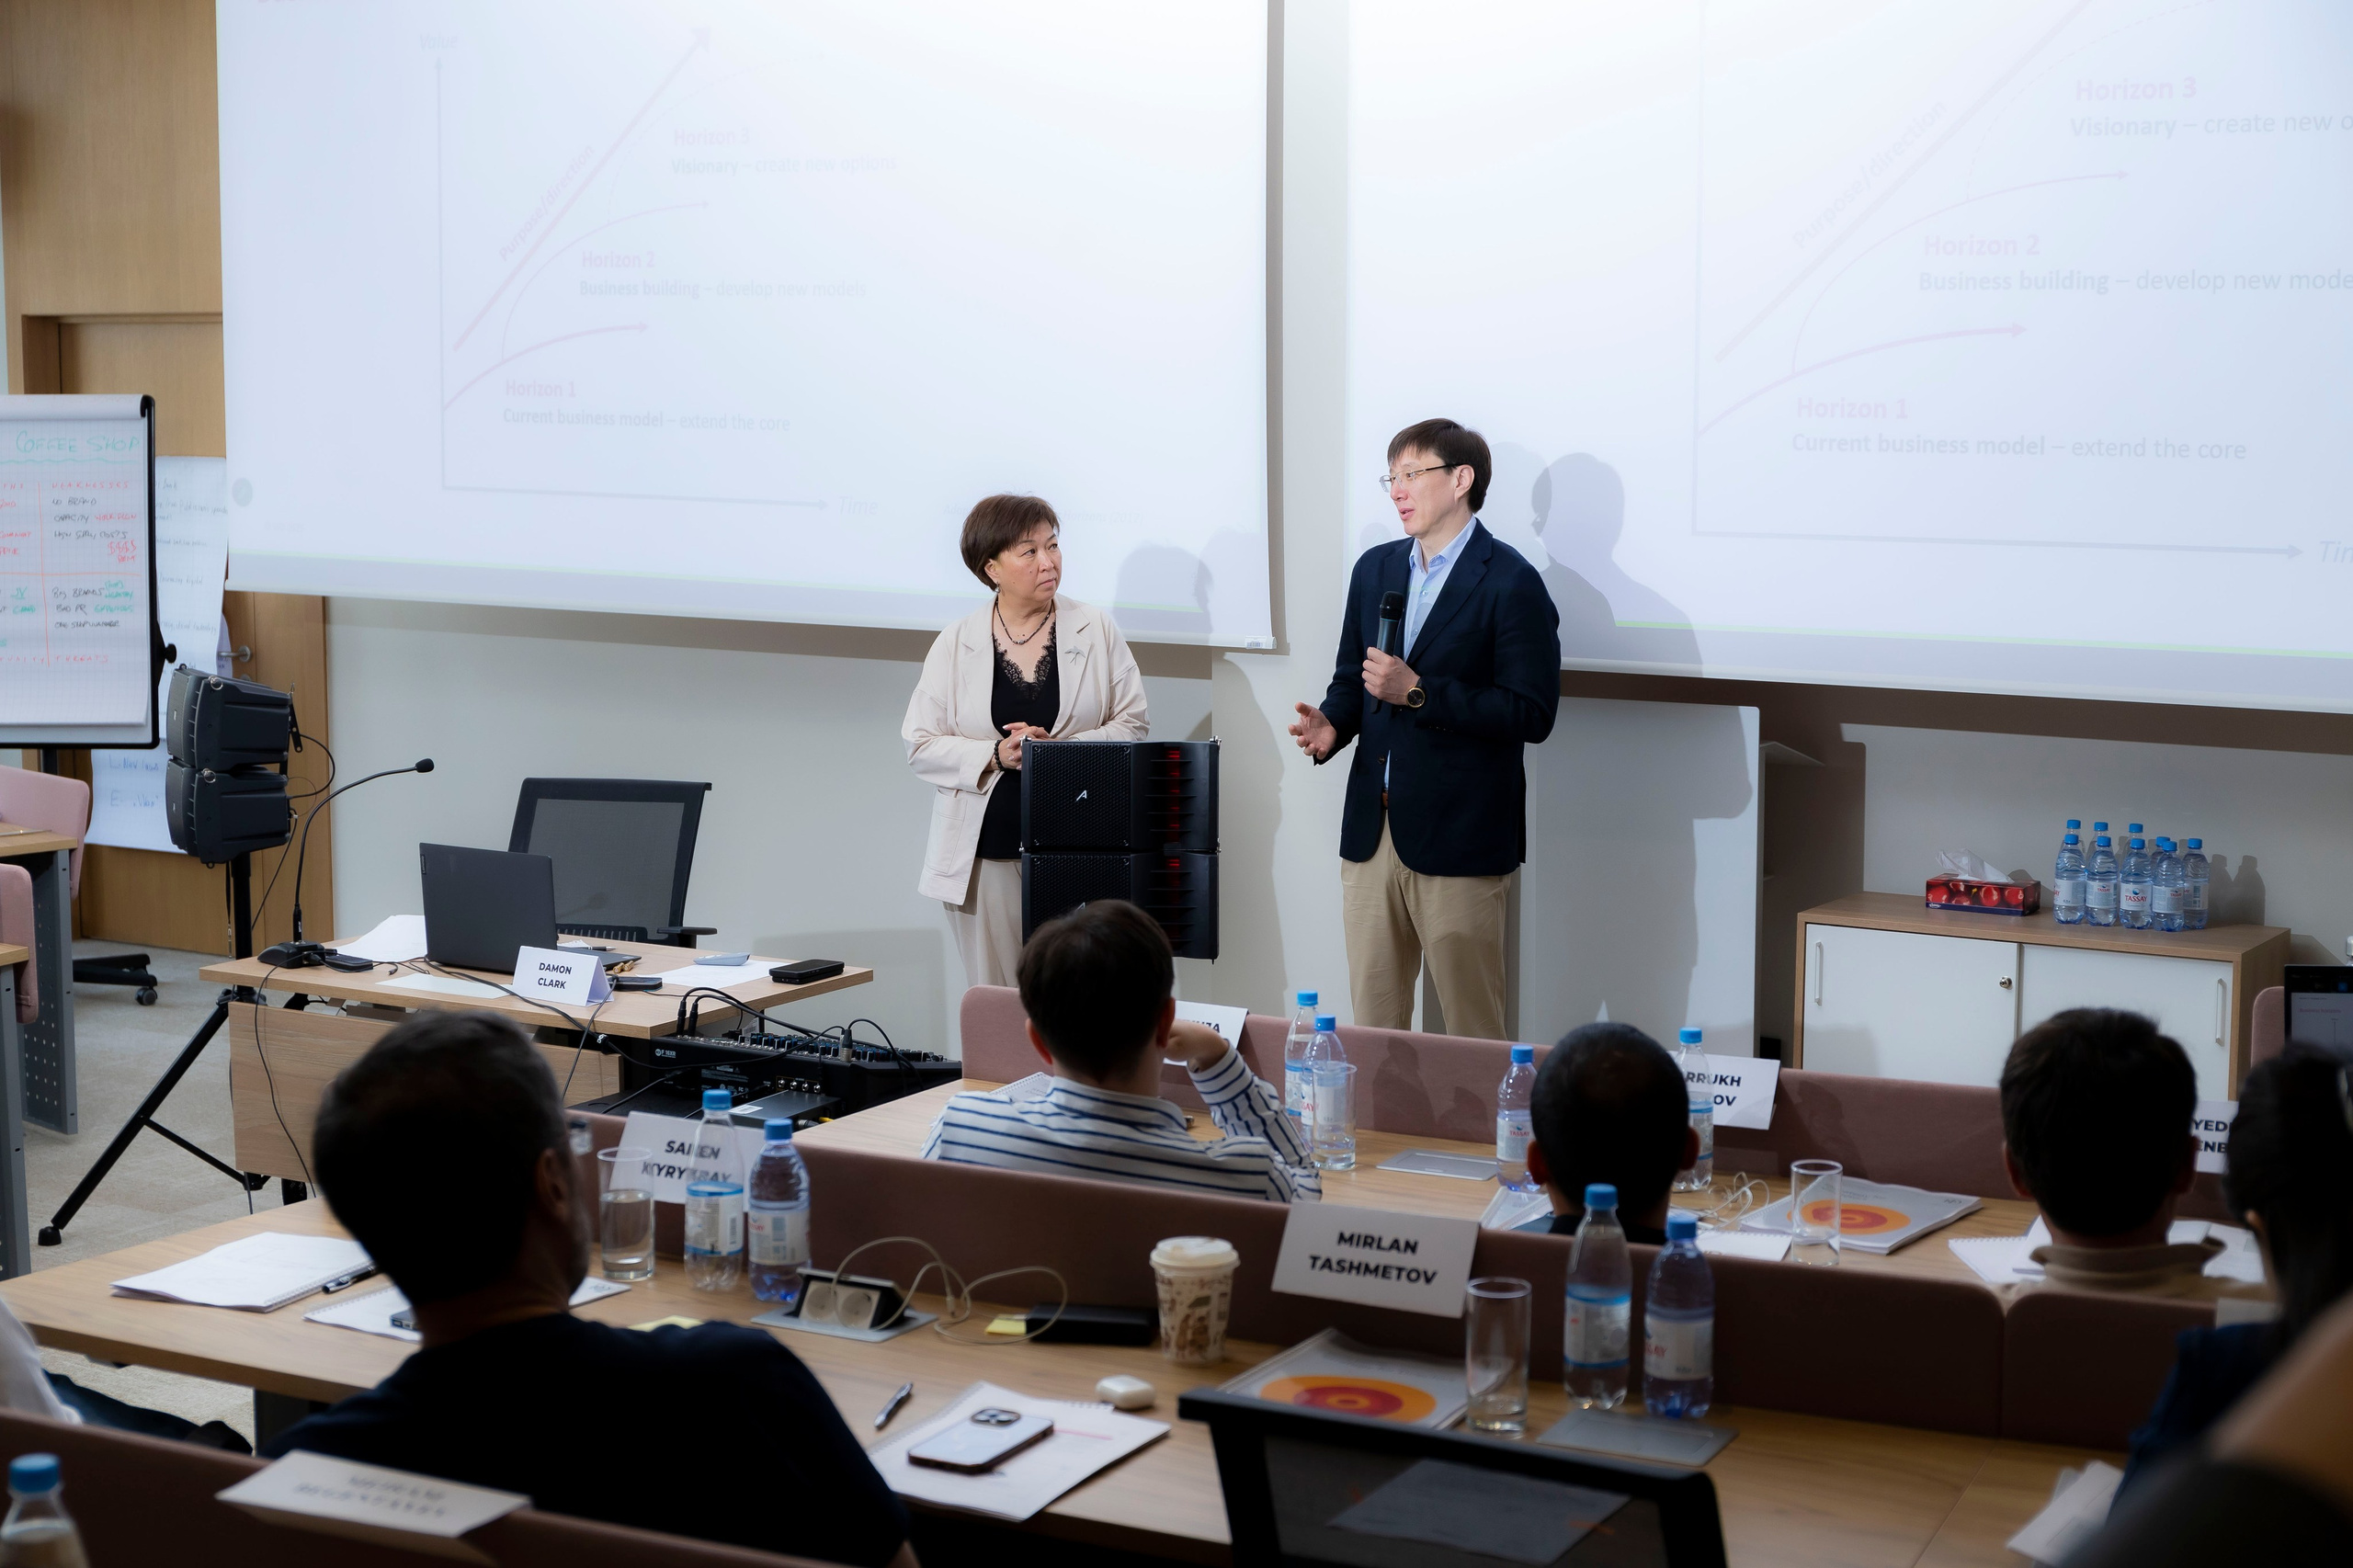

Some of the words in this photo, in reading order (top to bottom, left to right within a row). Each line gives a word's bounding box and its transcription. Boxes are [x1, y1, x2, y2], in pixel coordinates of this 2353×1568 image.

[419, 33, 459, 51] Value
[2075, 79, 2174, 102] Horizon
[2181, 76, 2198, 100] 3
[674, 129, 735, 146] Horizon
[741, 127, 750, 144] 3
[2070, 116, 2177, 141] Visionary
[2203, 113, 2276, 133] create
[2283, 114, 2333, 132] new
[671, 158, 739, 177] Visionary
[755, 157, 801, 174] create
[805, 157, 835, 172] new
[840, 154, 897, 176] options
[1792, 97, 1949, 250] Purpose/direction
[498, 144, 596, 262] Purpose/direction
[1924, 235, 2016, 256] Horizon
[2026, 234, 2040, 256] 2
[582, 250, 642, 268] Horizon
[645, 250, 656, 268] 2
[579, 279, 639, 297] Business
[642, 278, 700, 300] building
[715, 278, 773, 300] develop
[778, 281, 808, 297] new
[813, 278, 867, 297] models
[1918, 272, 2013, 292] Business
[2018, 270, 2109, 295] building
[2136, 269, 2226, 295] develop
[2233, 273, 2282, 291] new
[506, 379, 563, 397] Horizon
[568, 381, 576, 398] 1
[1797, 397, 1887, 420] Horizon
[1895, 398, 1909, 420] 1
[503, 408, 553, 425] Current
[557, 408, 616, 426] business
[619, 410, 664, 427] model
[679, 414, 728, 430] extend
[732, 414, 755, 431] the
[759, 415, 790, 432] core
[16, 429, 78, 453] COFFEE
[86, 434, 141, 452] SHOP
[1791, 432, 1871, 453] Current
[1878, 433, 1970, 455] business
[1975, 435, 2046, 456] model
[2071, 437, 2146, 459] extend
[2154, 437, 2190, 459] the
[2198, 441, 2247, 460] core
[838, 495, 880, 517] Time
[2124, 894, 2148, 903] TASSAY
[538, 962, 573, 975] DAMON
[537, 977, 567, 990] CLARK
[1684, 1071, 1742, 1087] RRUKH
[1713, 1094, 1737, 1107] OV
[1336, 1230, 1420, 1256] MIRLAN
[1308, 1255, 1439, 1285] TASHMETOV
